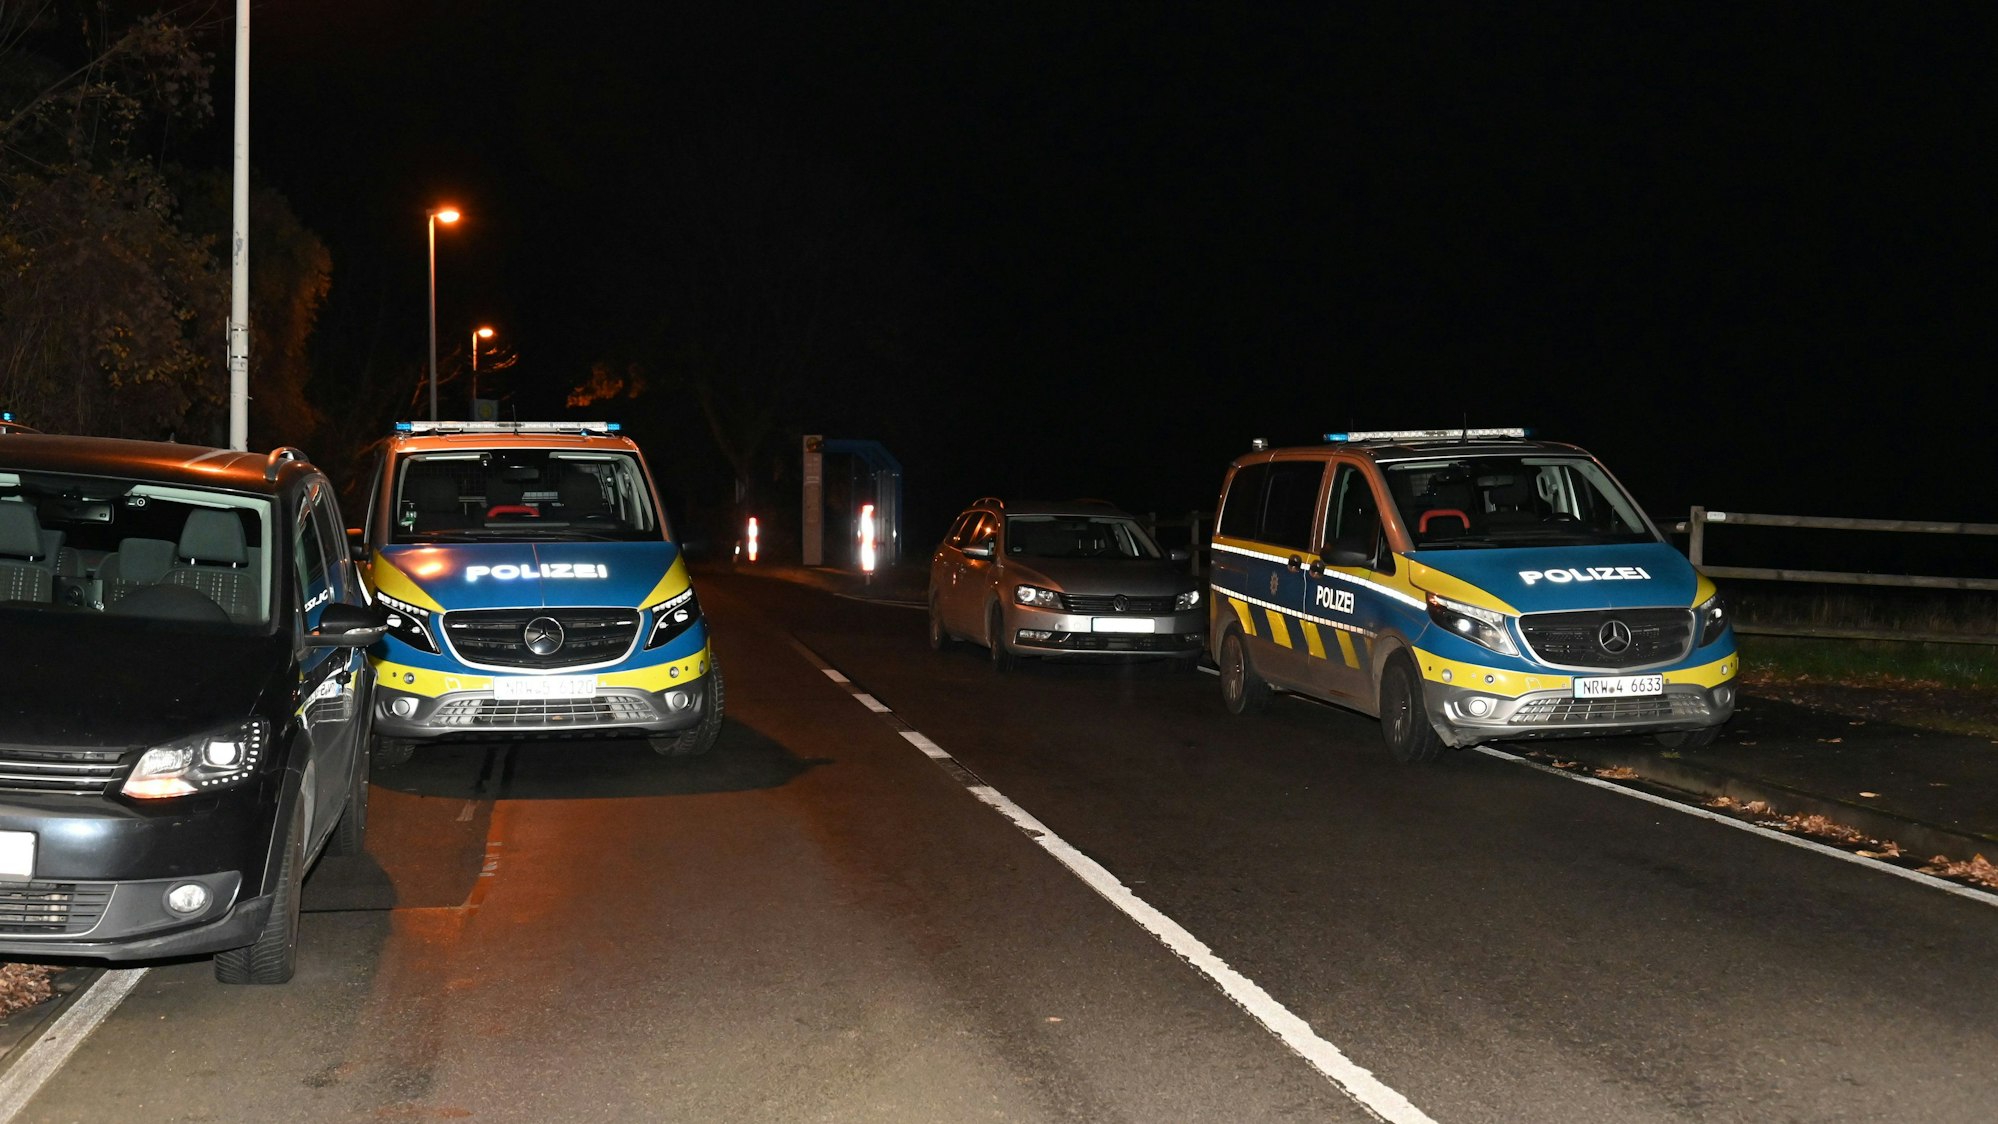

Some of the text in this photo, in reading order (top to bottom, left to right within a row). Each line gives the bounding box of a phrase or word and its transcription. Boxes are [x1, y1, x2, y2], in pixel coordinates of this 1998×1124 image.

[466, 563, 608, 582] POLIZEI
[1519, 567, 1651, 585] POLIZEI
[1316, 585, 1354, 614] POLIZEI
[1583, 677, 1661, 694] NRW 4 6633
